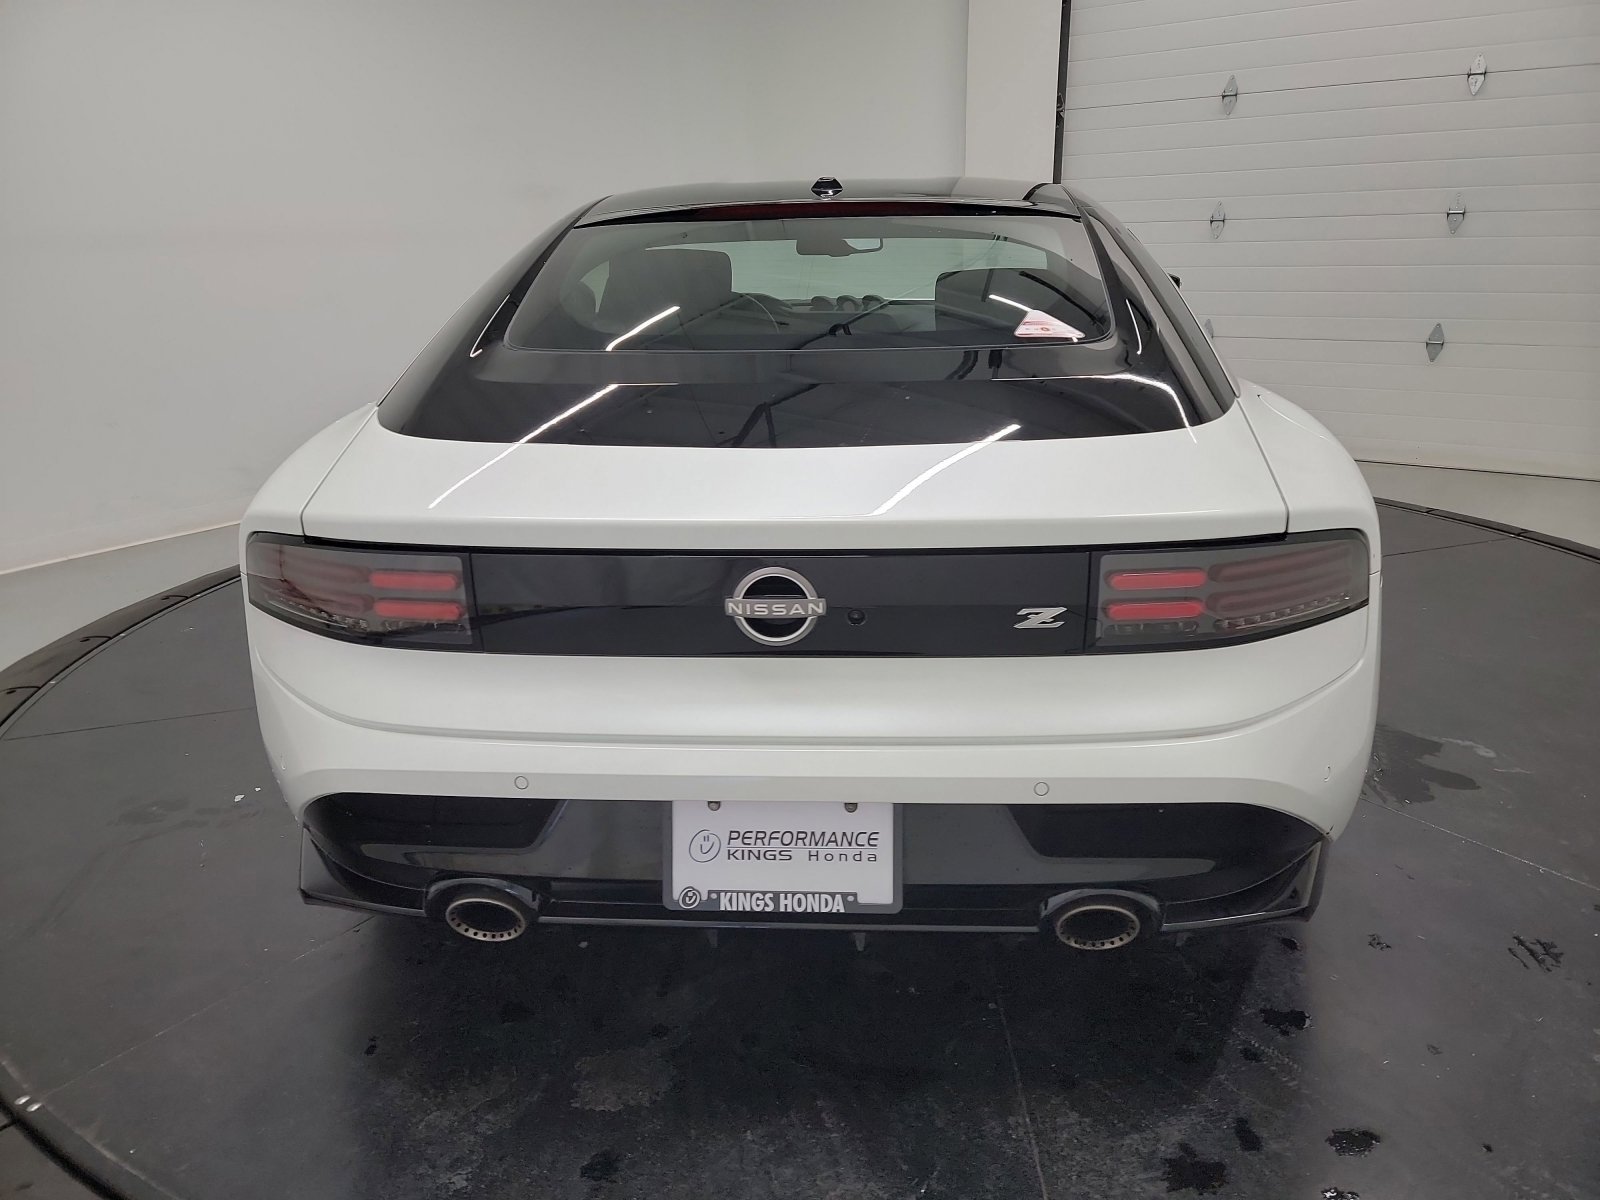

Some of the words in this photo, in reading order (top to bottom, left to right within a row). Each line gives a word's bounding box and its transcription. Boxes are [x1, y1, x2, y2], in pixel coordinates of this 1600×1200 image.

[727, 602, 824, 616] NISSAN
[1013, 606, 1068, 629] Z
[727, 830, 880, 848] PERFORMANCE
[727, 849, 793, 861] KINGS
[808, 850, 878, 862] Honda
[719, 892, 775, 912] KINGS
[779, 893, 846, 913] HONDA
